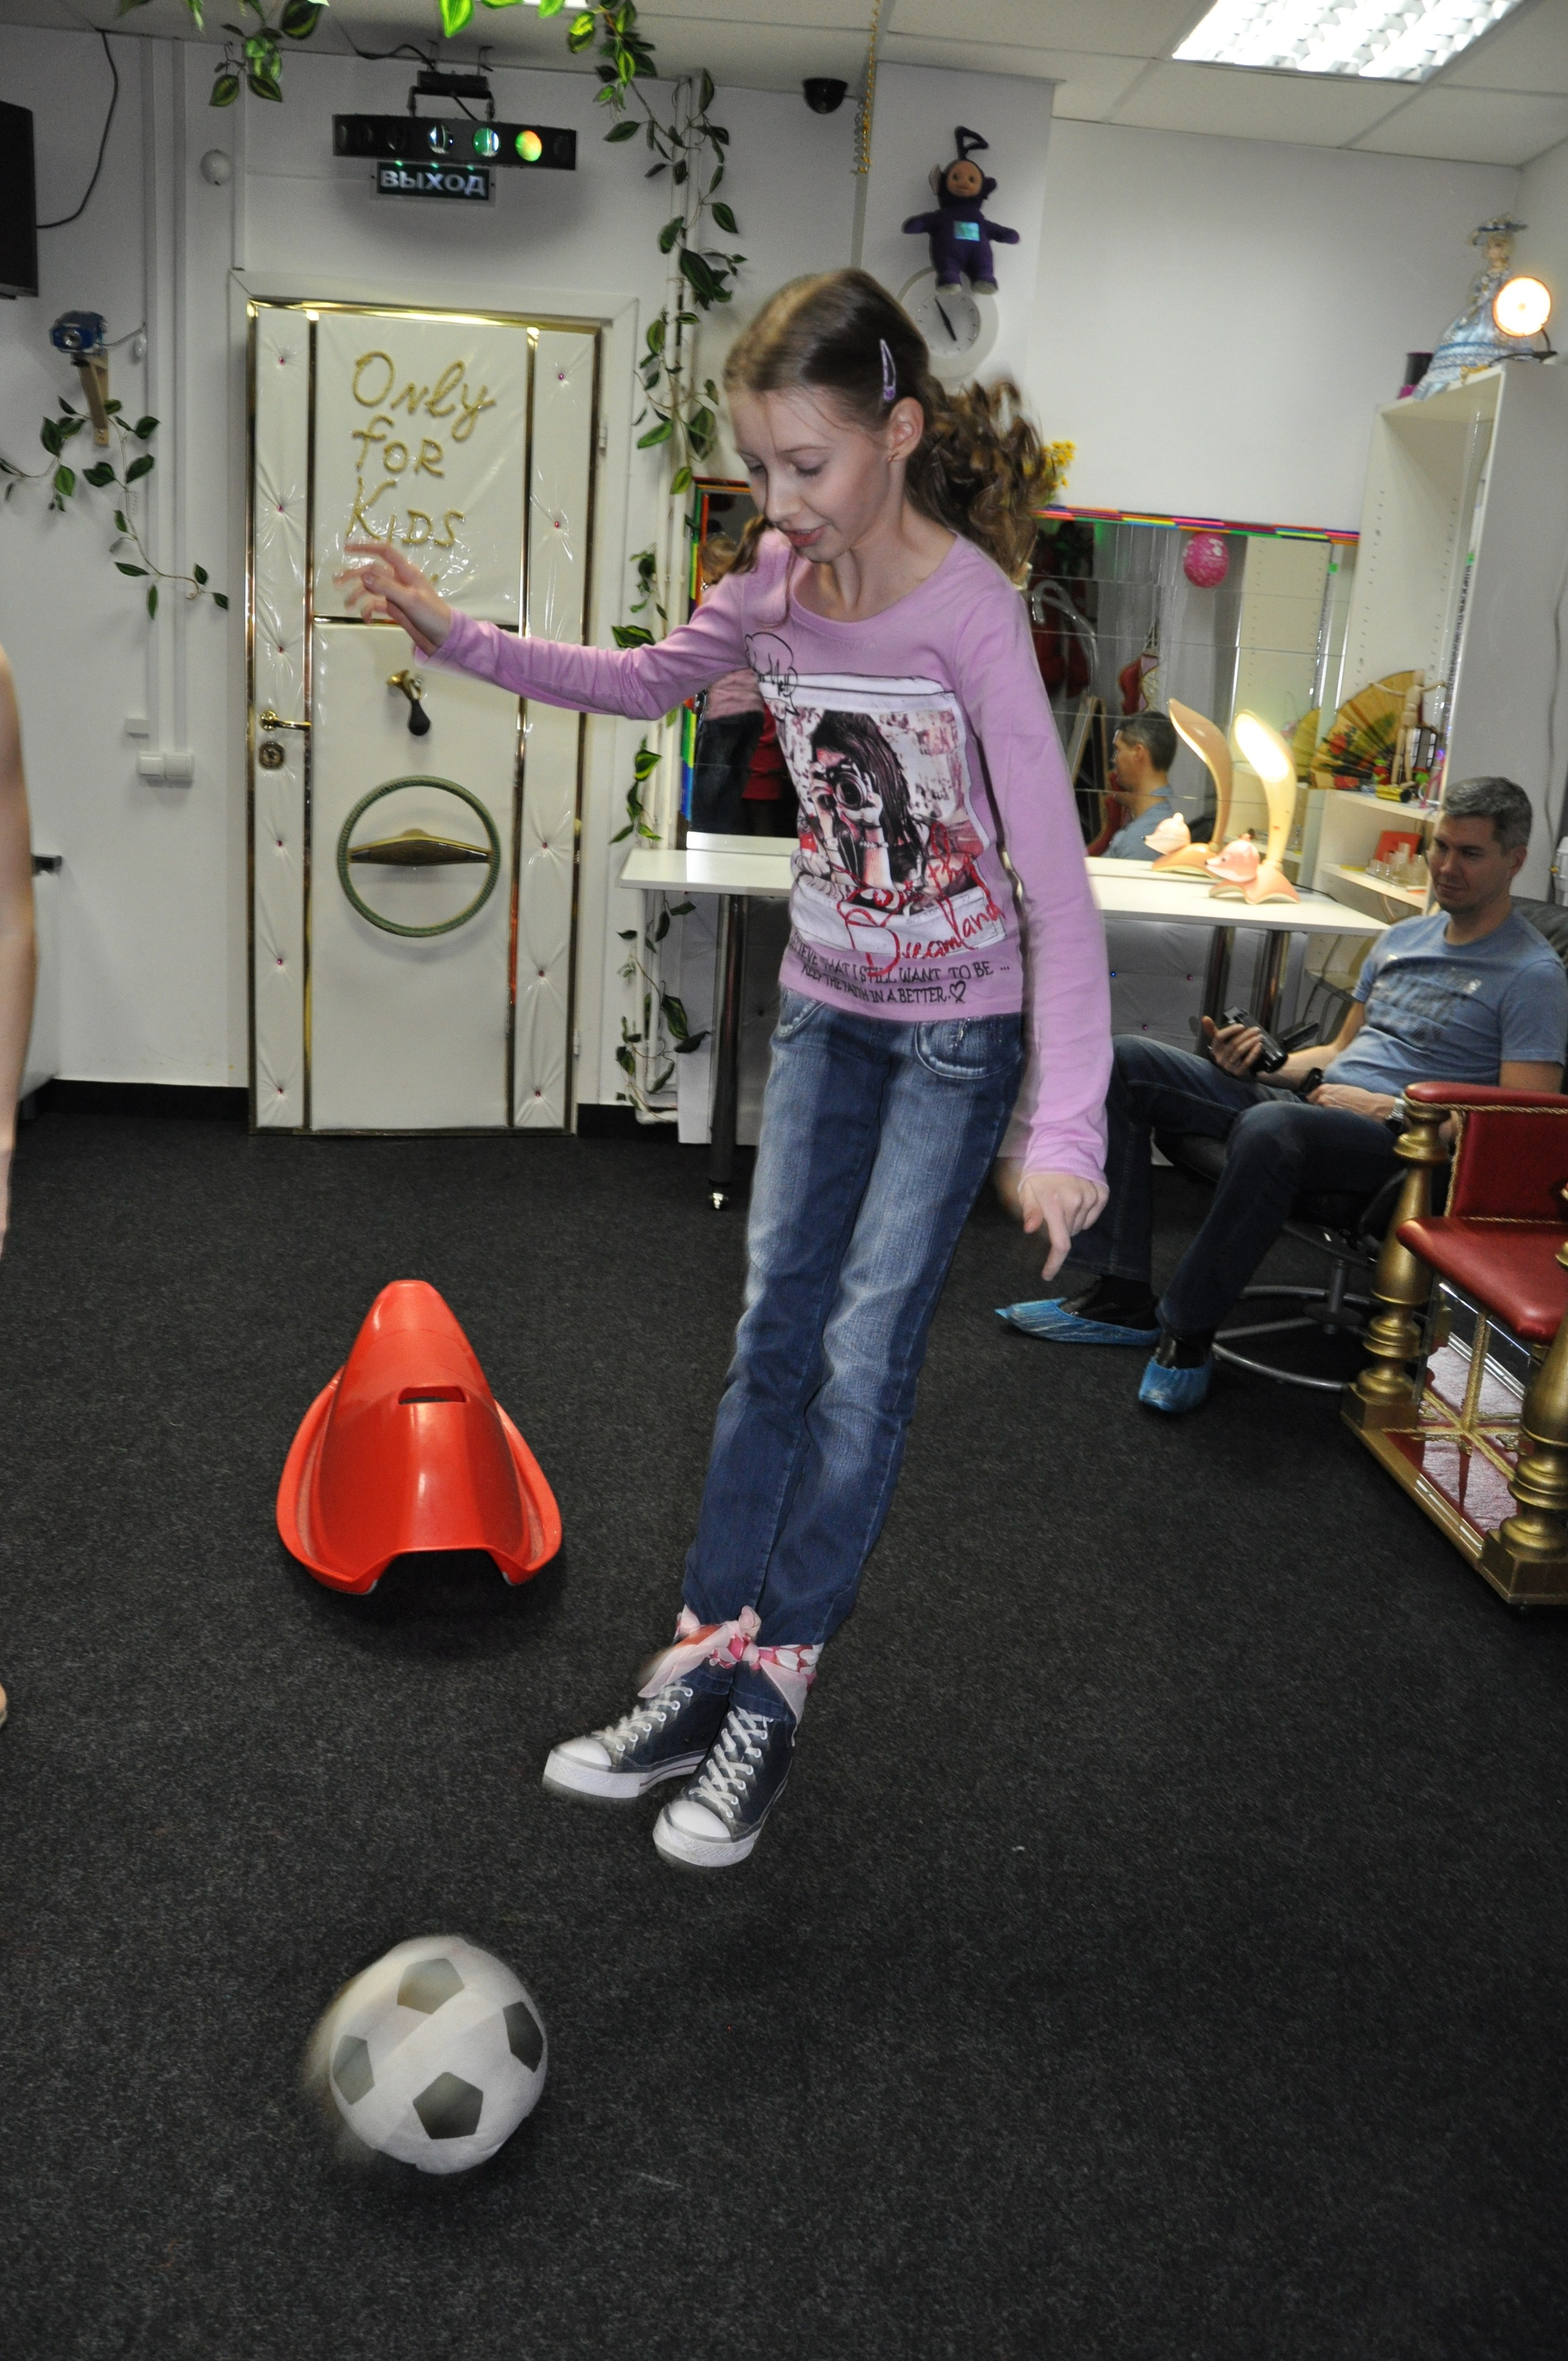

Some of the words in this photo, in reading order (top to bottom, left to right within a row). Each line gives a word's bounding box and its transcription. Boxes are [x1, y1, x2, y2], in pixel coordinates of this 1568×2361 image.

[380, 169, 486, 197] ВЫХОД
[351, 350, 497, 442] Only
[899, 967, 941, 984] WANT
[948, 965, 972, 980] TO
[869, 990, 884, 1003] IN
[887, 988, 898, 1003] A
